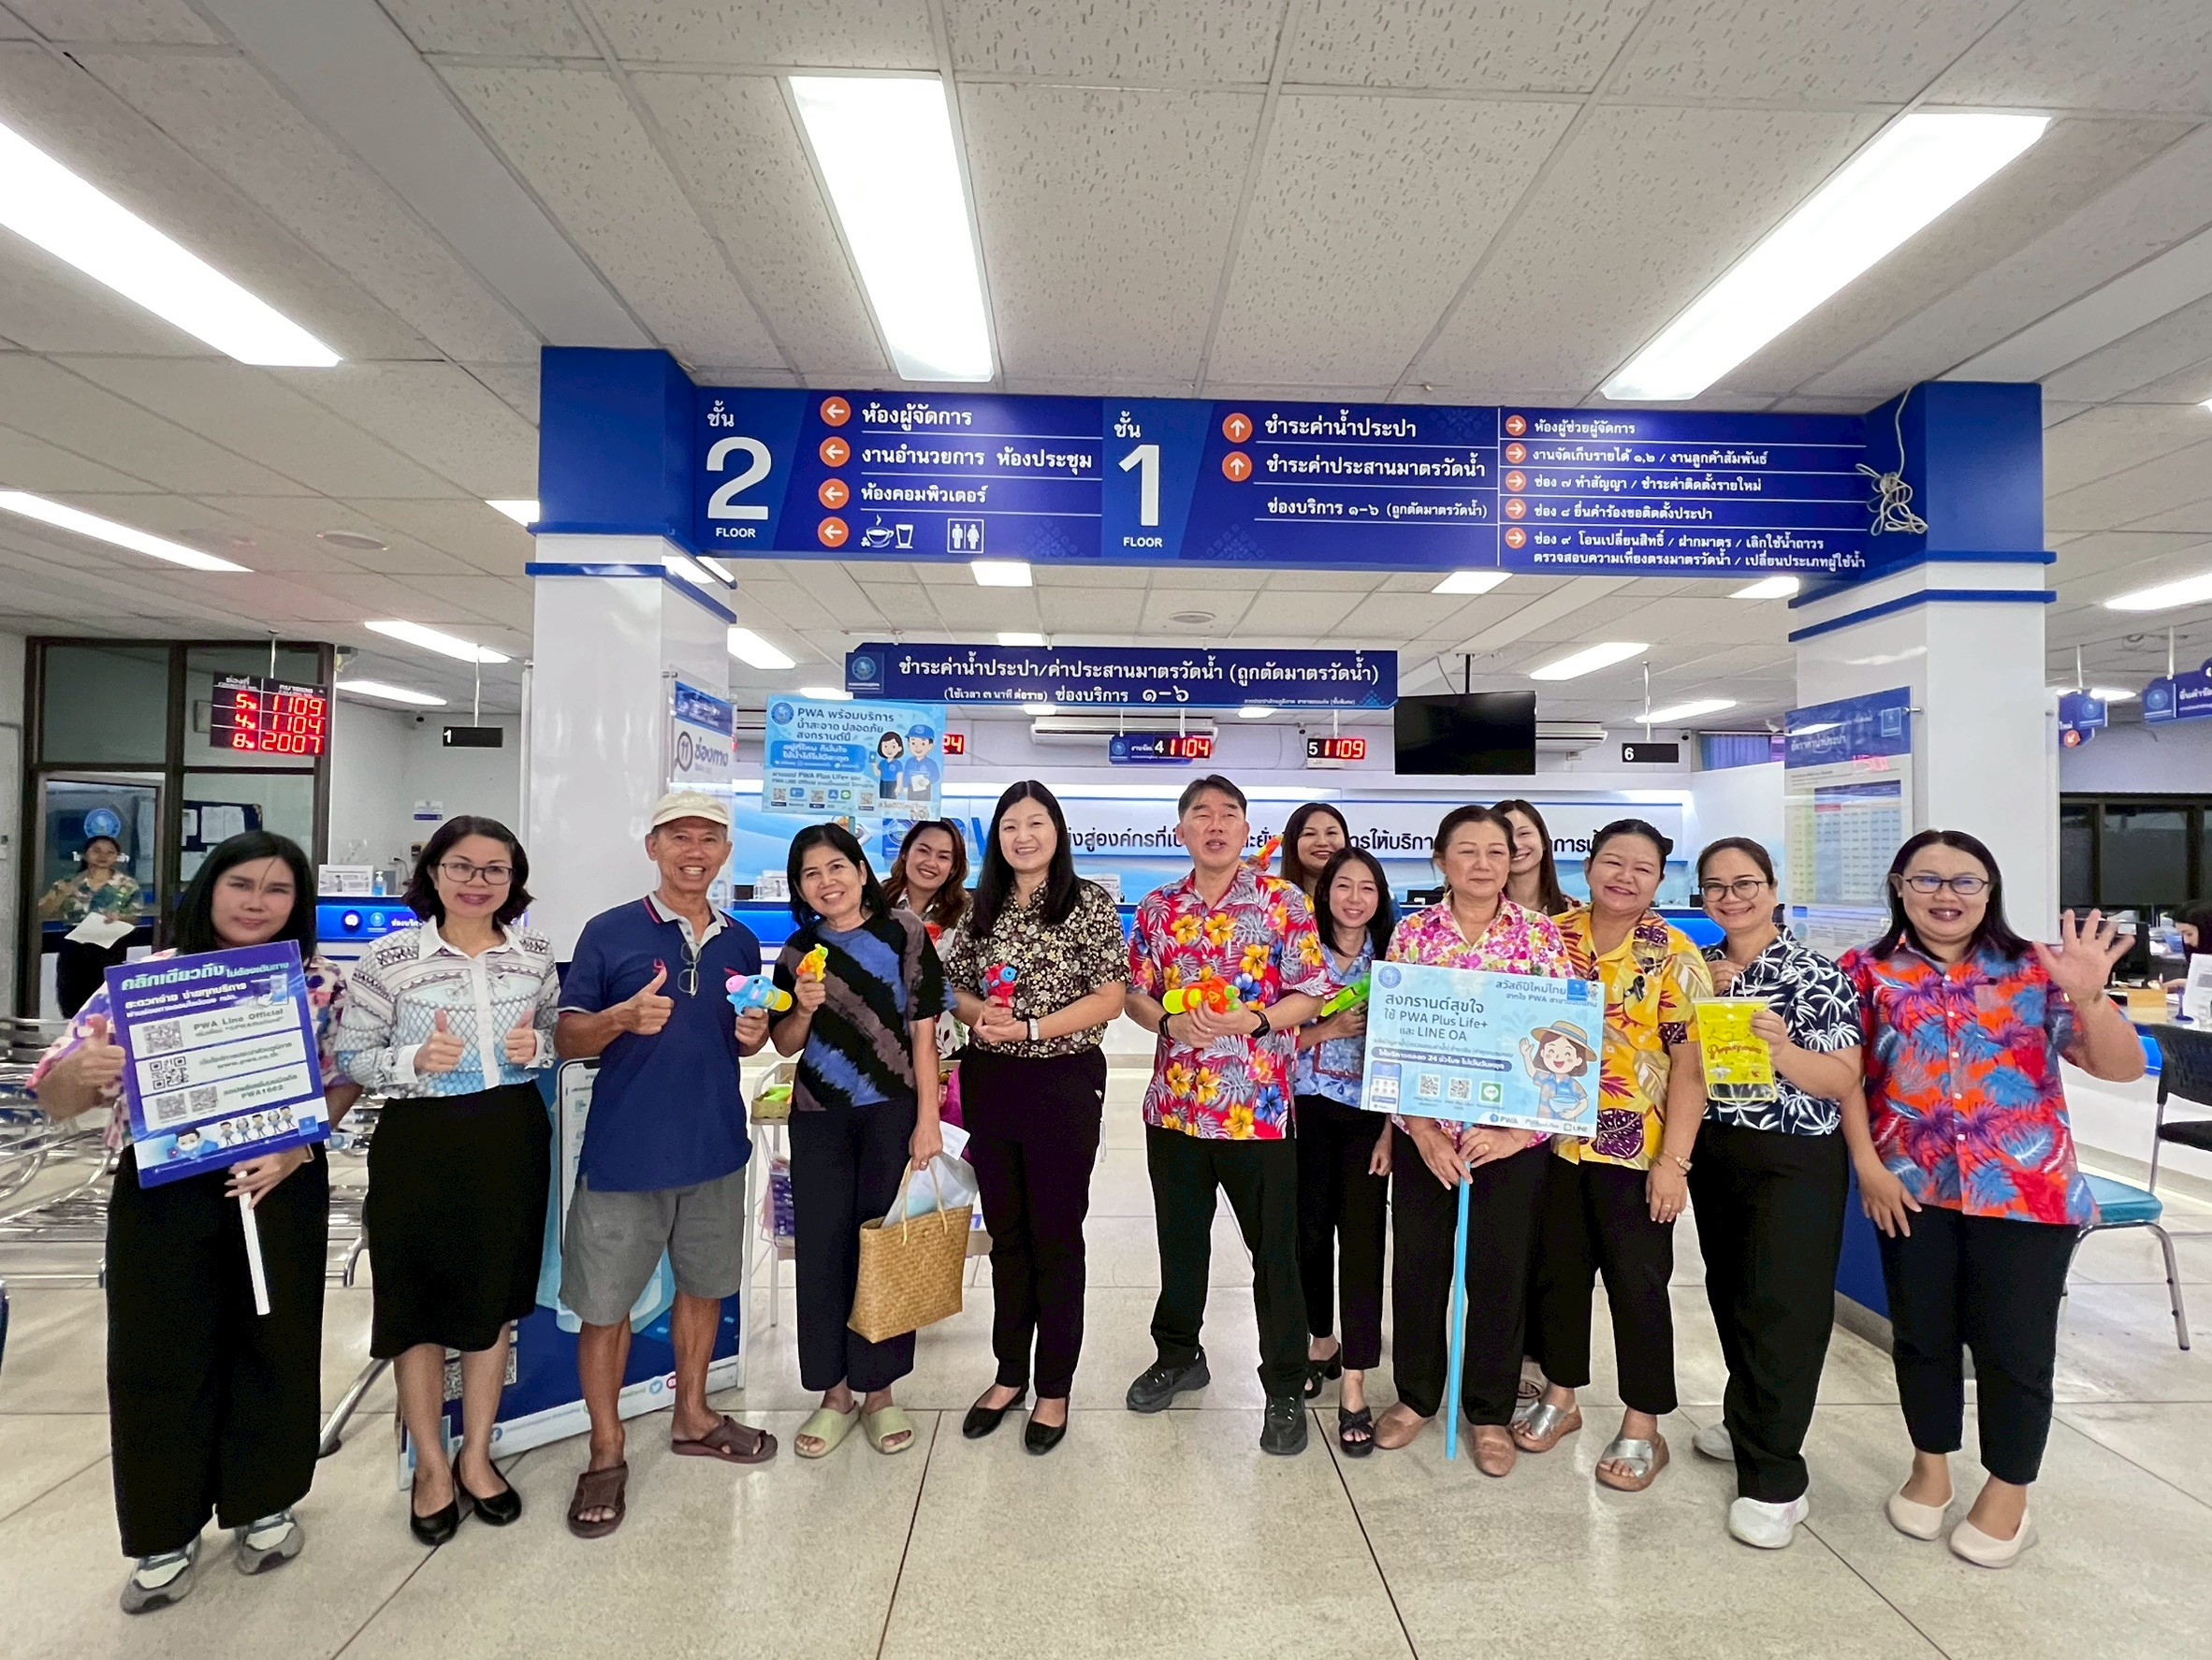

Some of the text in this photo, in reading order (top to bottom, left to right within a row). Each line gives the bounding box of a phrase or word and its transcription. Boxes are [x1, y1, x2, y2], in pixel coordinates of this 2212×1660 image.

[707, 400, 735, 428] ชั้น
[862, 404, 972, 431] ห้องผู้จัดการ
[1265, 409, 1417, 437] ชำระค่าน้ำประปา
[1114, 412, 1142, 438] ชั้น
[1535, 419, 1636, 438] ห้องผู้ช่วยผู้จัดการ
[862, 444, 1092, 474] งานอำนวยการ ห้องประชุม
[1266, 452, 1485, 476] ชำระค่าประสานมาตรวัดน้ำ
[1533, 446, 1632, 461] งานจัดเก็บรายได้
[1670, 450, 1768, 468] งานลูกค้าสัมพันธ์
[706, 436, 772, 519] 2
[1119, 444, 1160, 527] 1
[1535, 474, 1557, 488] ช่อง
[1561, 479, 1571, 488] ๗
[1576, 475, 1627, 492] ทำสัญญา
[1641, 473, 1762, 491] ชำระค่าติดตั้งรายใหม่
[861, 484, 988, 504] ห้องคอมพิวเตอร์
[1267, 497, 1343, 515] ช่องบริการ
[1387, 500, 1488, 519] (ถูกตัดมาตรวัดน้ำ)
[1534, 503, 1557, 517] ช่อง
[1574, 501, 1712, 519] ยื่นคำร้องขอติดตั้งประปา
[716, 527, 756, 538] FLOOR
[1124, 536, 1162, 547] FLOOR
[1534, 531, 1557, 545] ช่อง
[1561, 536, 1572, 546] ๙
[899, 651, 1378, 686] ชำระค่าน้ำประปา/ค่าประสานมาตรวัดน้ำ (ถูกตัดมาตรวัดน้ำ)
[1055, 685, 1128, 702] ช่องบริการ
[236, 693, 323, 717] 5 1109
[797, 707, 895, 722] PWA พร้อมบริการ
[235, 714, 321, 735] 4 1104
[797, 717, 883, 734] น้ำสะอาด ปลอดภัย
[232, 732, 320, 754] 8 2007
[444, 729, 452, 743] 1
[1155, 740, 1164, 753] 4
[1170, 738, 1210, 757] 1104
[1308, 742, 1318, 755] 5
[1325, 739, 1364, 758] 1109
[1624, 747, 1635, 761] 6
[1385, 994, 1484, 1015] สงกรานต์สุขใจ
[194, 1020, 218, 1030] PWA
[249, 1009, 284, 1020] Official
[1400, 1011, 1428, 1024] PWA
[1432, 1014, 1456, 1027] Plus
[1459, 1017, 1488, 1029] Life+
[1418, 1027, 1446, 1039] LINE
[1448, 1029, 1467, 1041] OA
